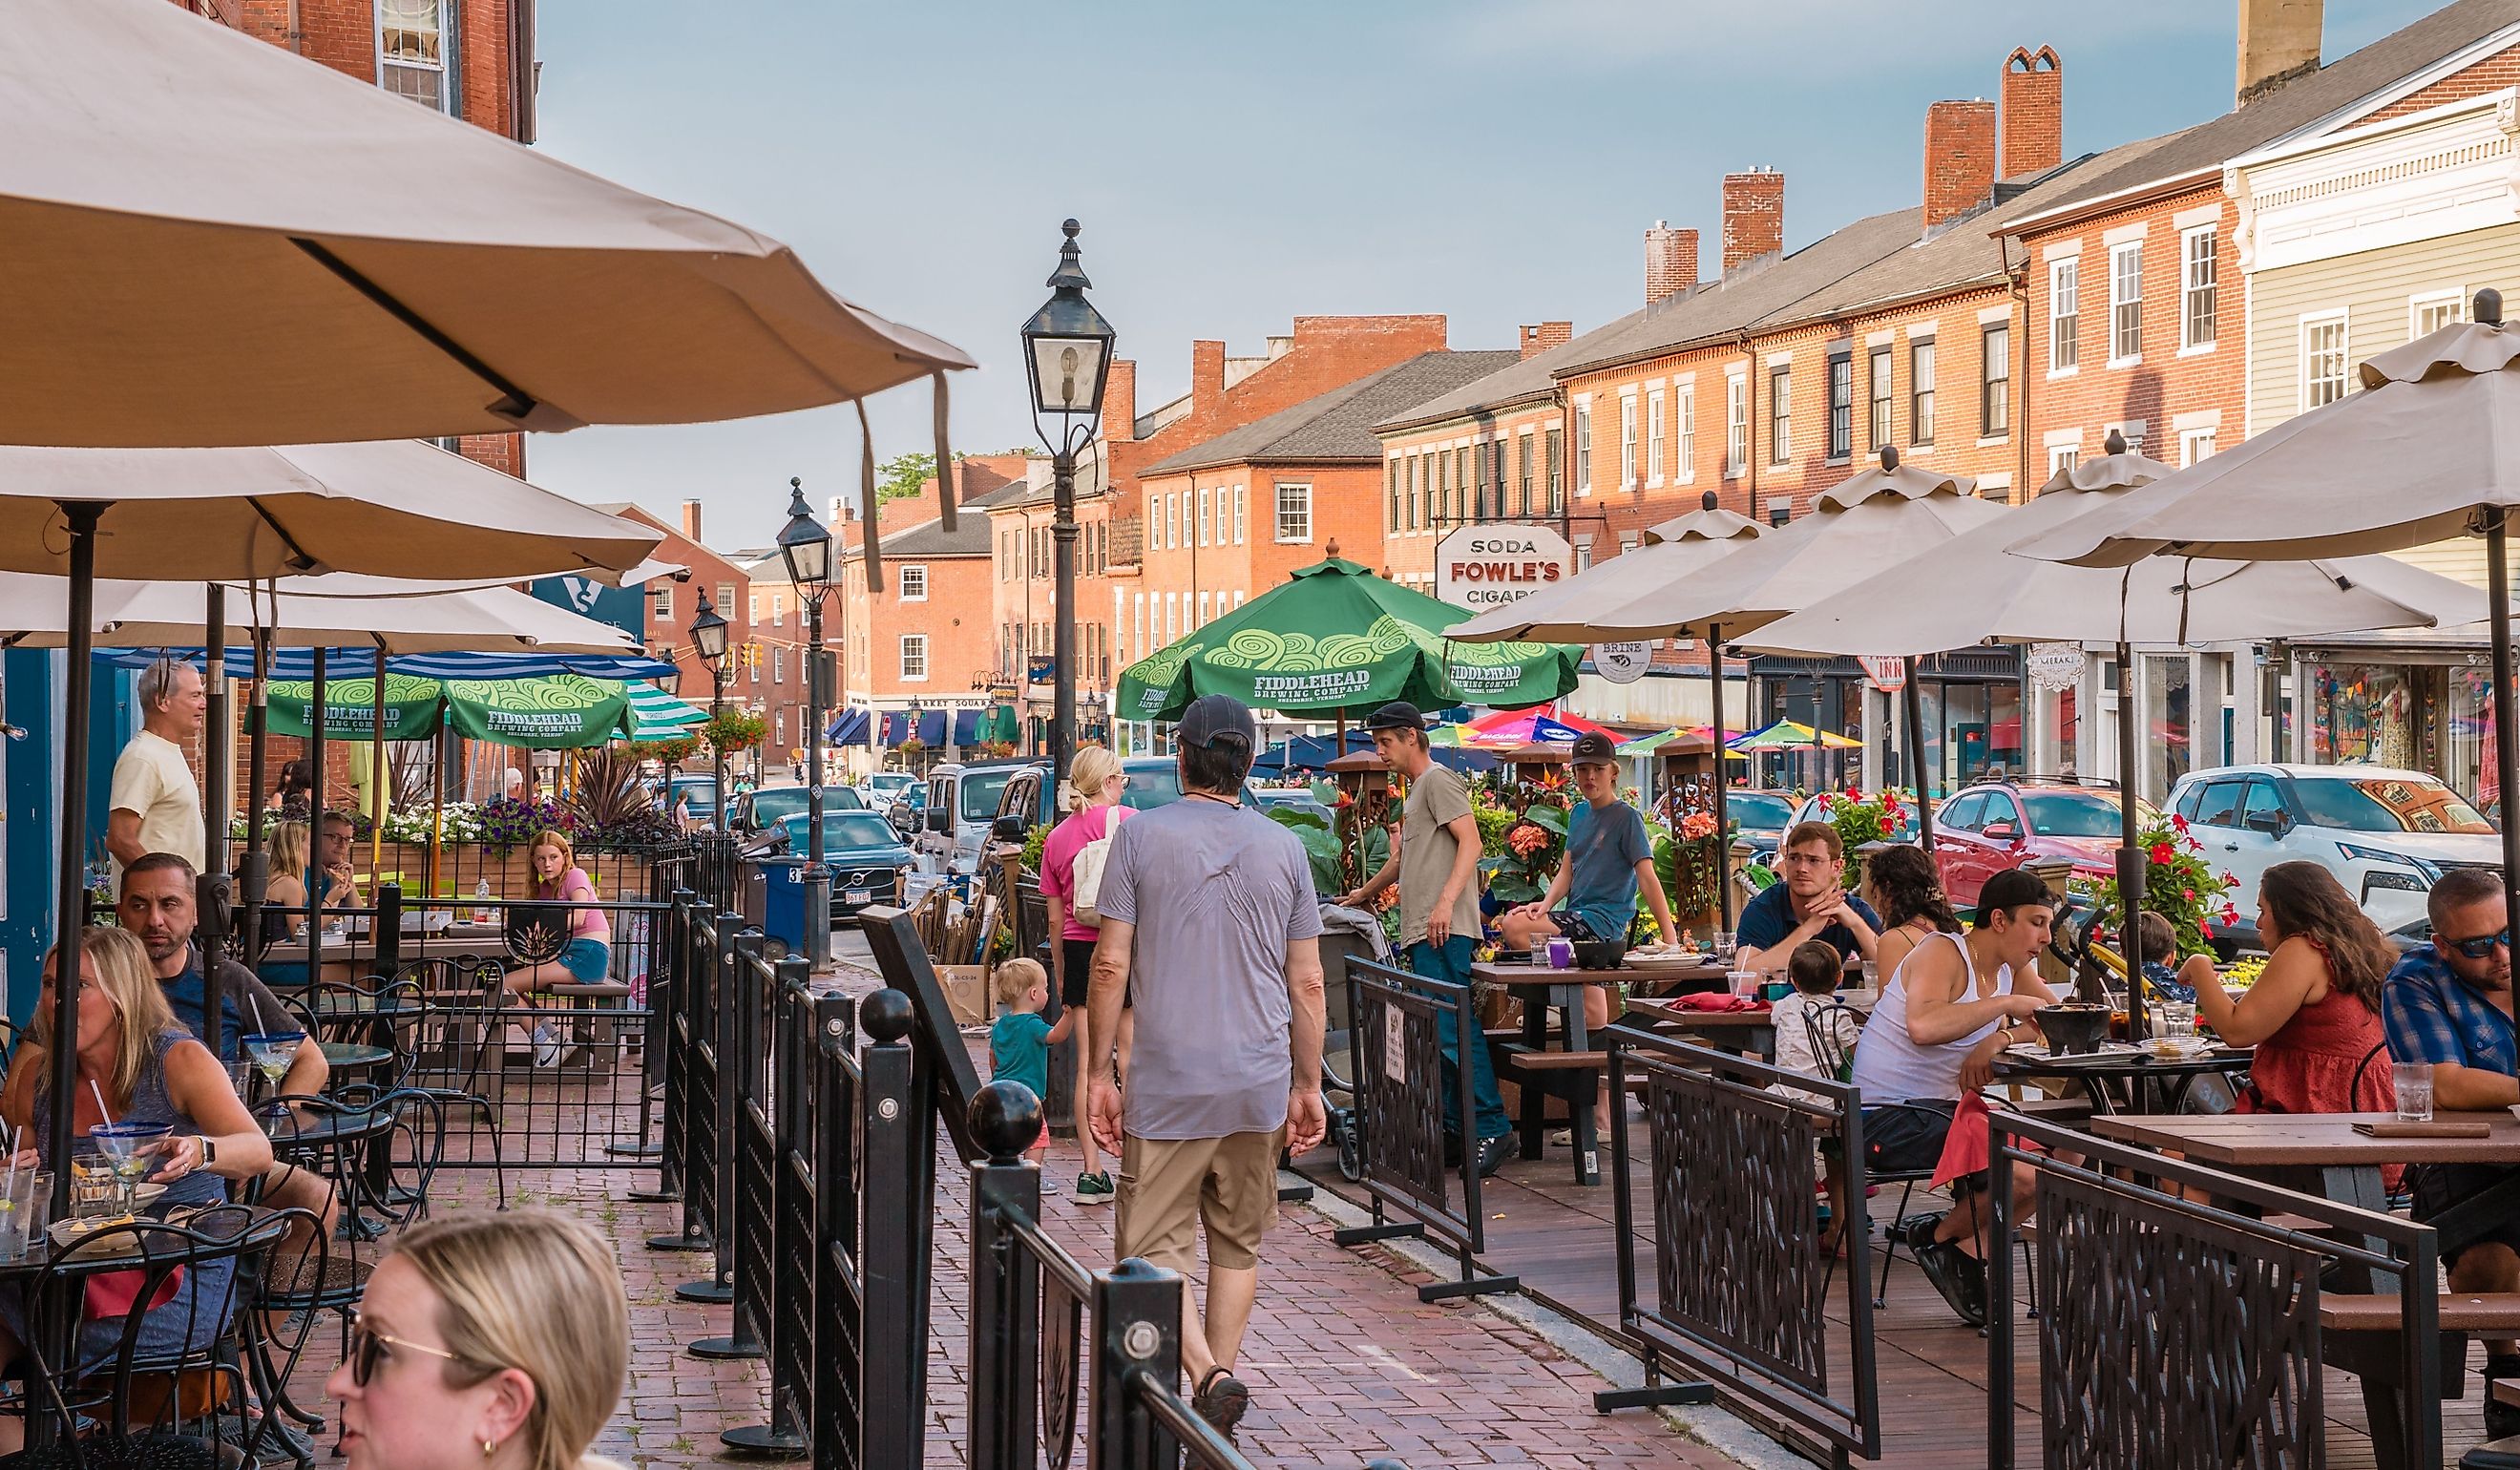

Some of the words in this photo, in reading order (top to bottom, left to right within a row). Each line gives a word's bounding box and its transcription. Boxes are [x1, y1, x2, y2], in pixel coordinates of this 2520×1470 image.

[1470, 540, 1537, 554] SODA
[1451, 561, 1560, 582] FOWLE'S
[1466, 590, 1539, 603] CIGAR
[1604, 642, 1642, 653] BRINE
[2039, 656, 2074, 665] MERAKI
[1450, 664, 1522, 682] FIDDLEHEAD
[1879, 662, 1902, 679] INN
[1253, 670, 1371, 691] FIDDLEHEAD
[1253, 689, 1311, 699] BREWING
[1312, 683, 1371, 697] COMPANY
[908, 699, 948, 708] MRKET
[488, 710, 582, 725] FIDDLEHEAD
[487, 723, 535, 732] BREWING
[537, 724, 583, 733] COMPANY
